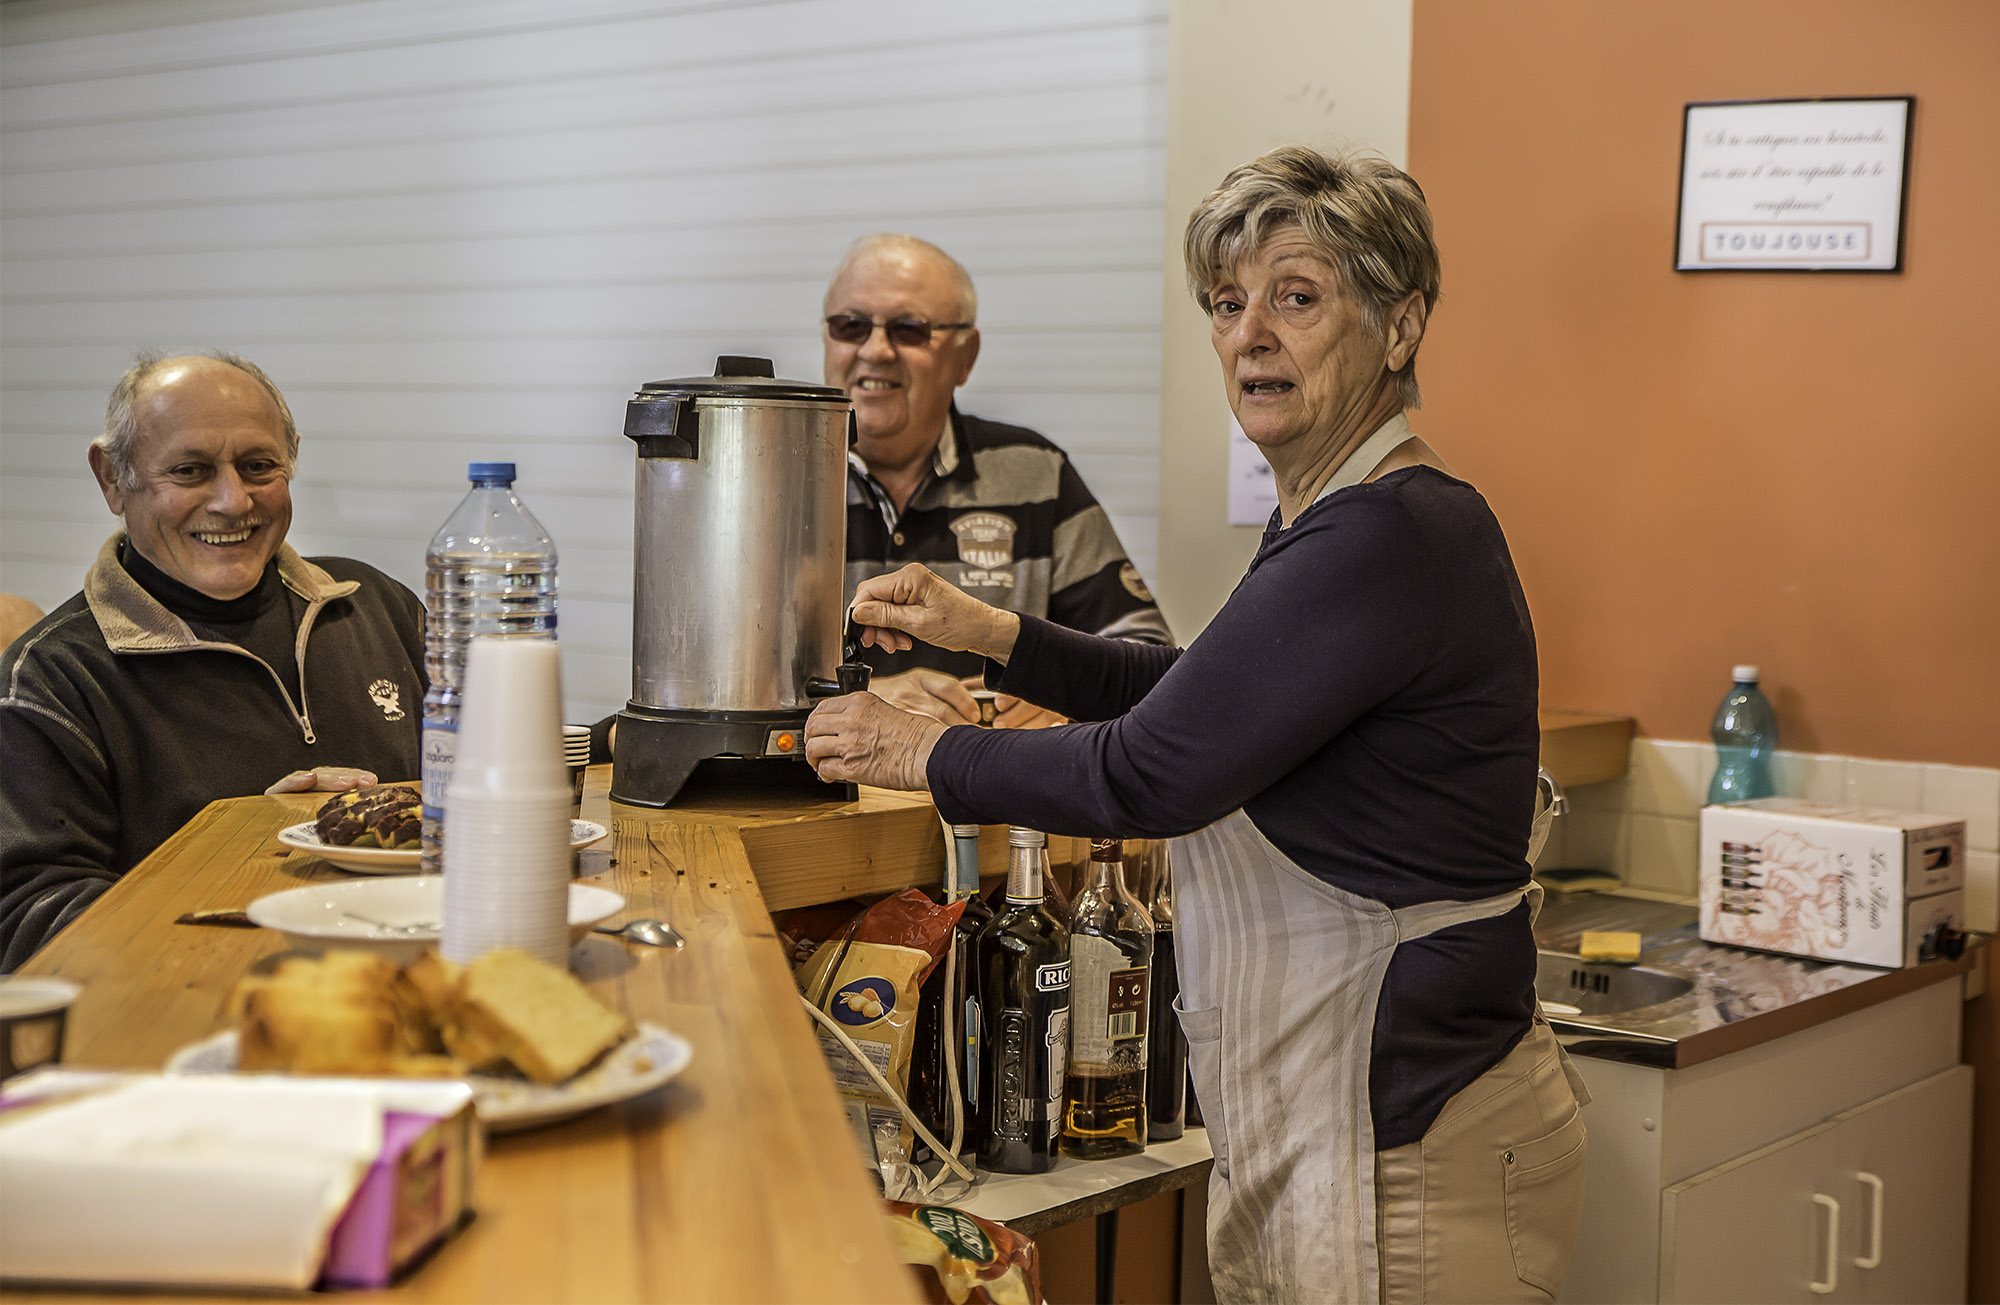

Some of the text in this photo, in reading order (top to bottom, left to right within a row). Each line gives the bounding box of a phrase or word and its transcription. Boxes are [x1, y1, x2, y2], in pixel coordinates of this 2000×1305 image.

[1714, 232, 1858, 251] TOUJOUSE
[1045, 968, 1070, 985] RIC
[1003, 1017, 1022, 1129] RICARD
